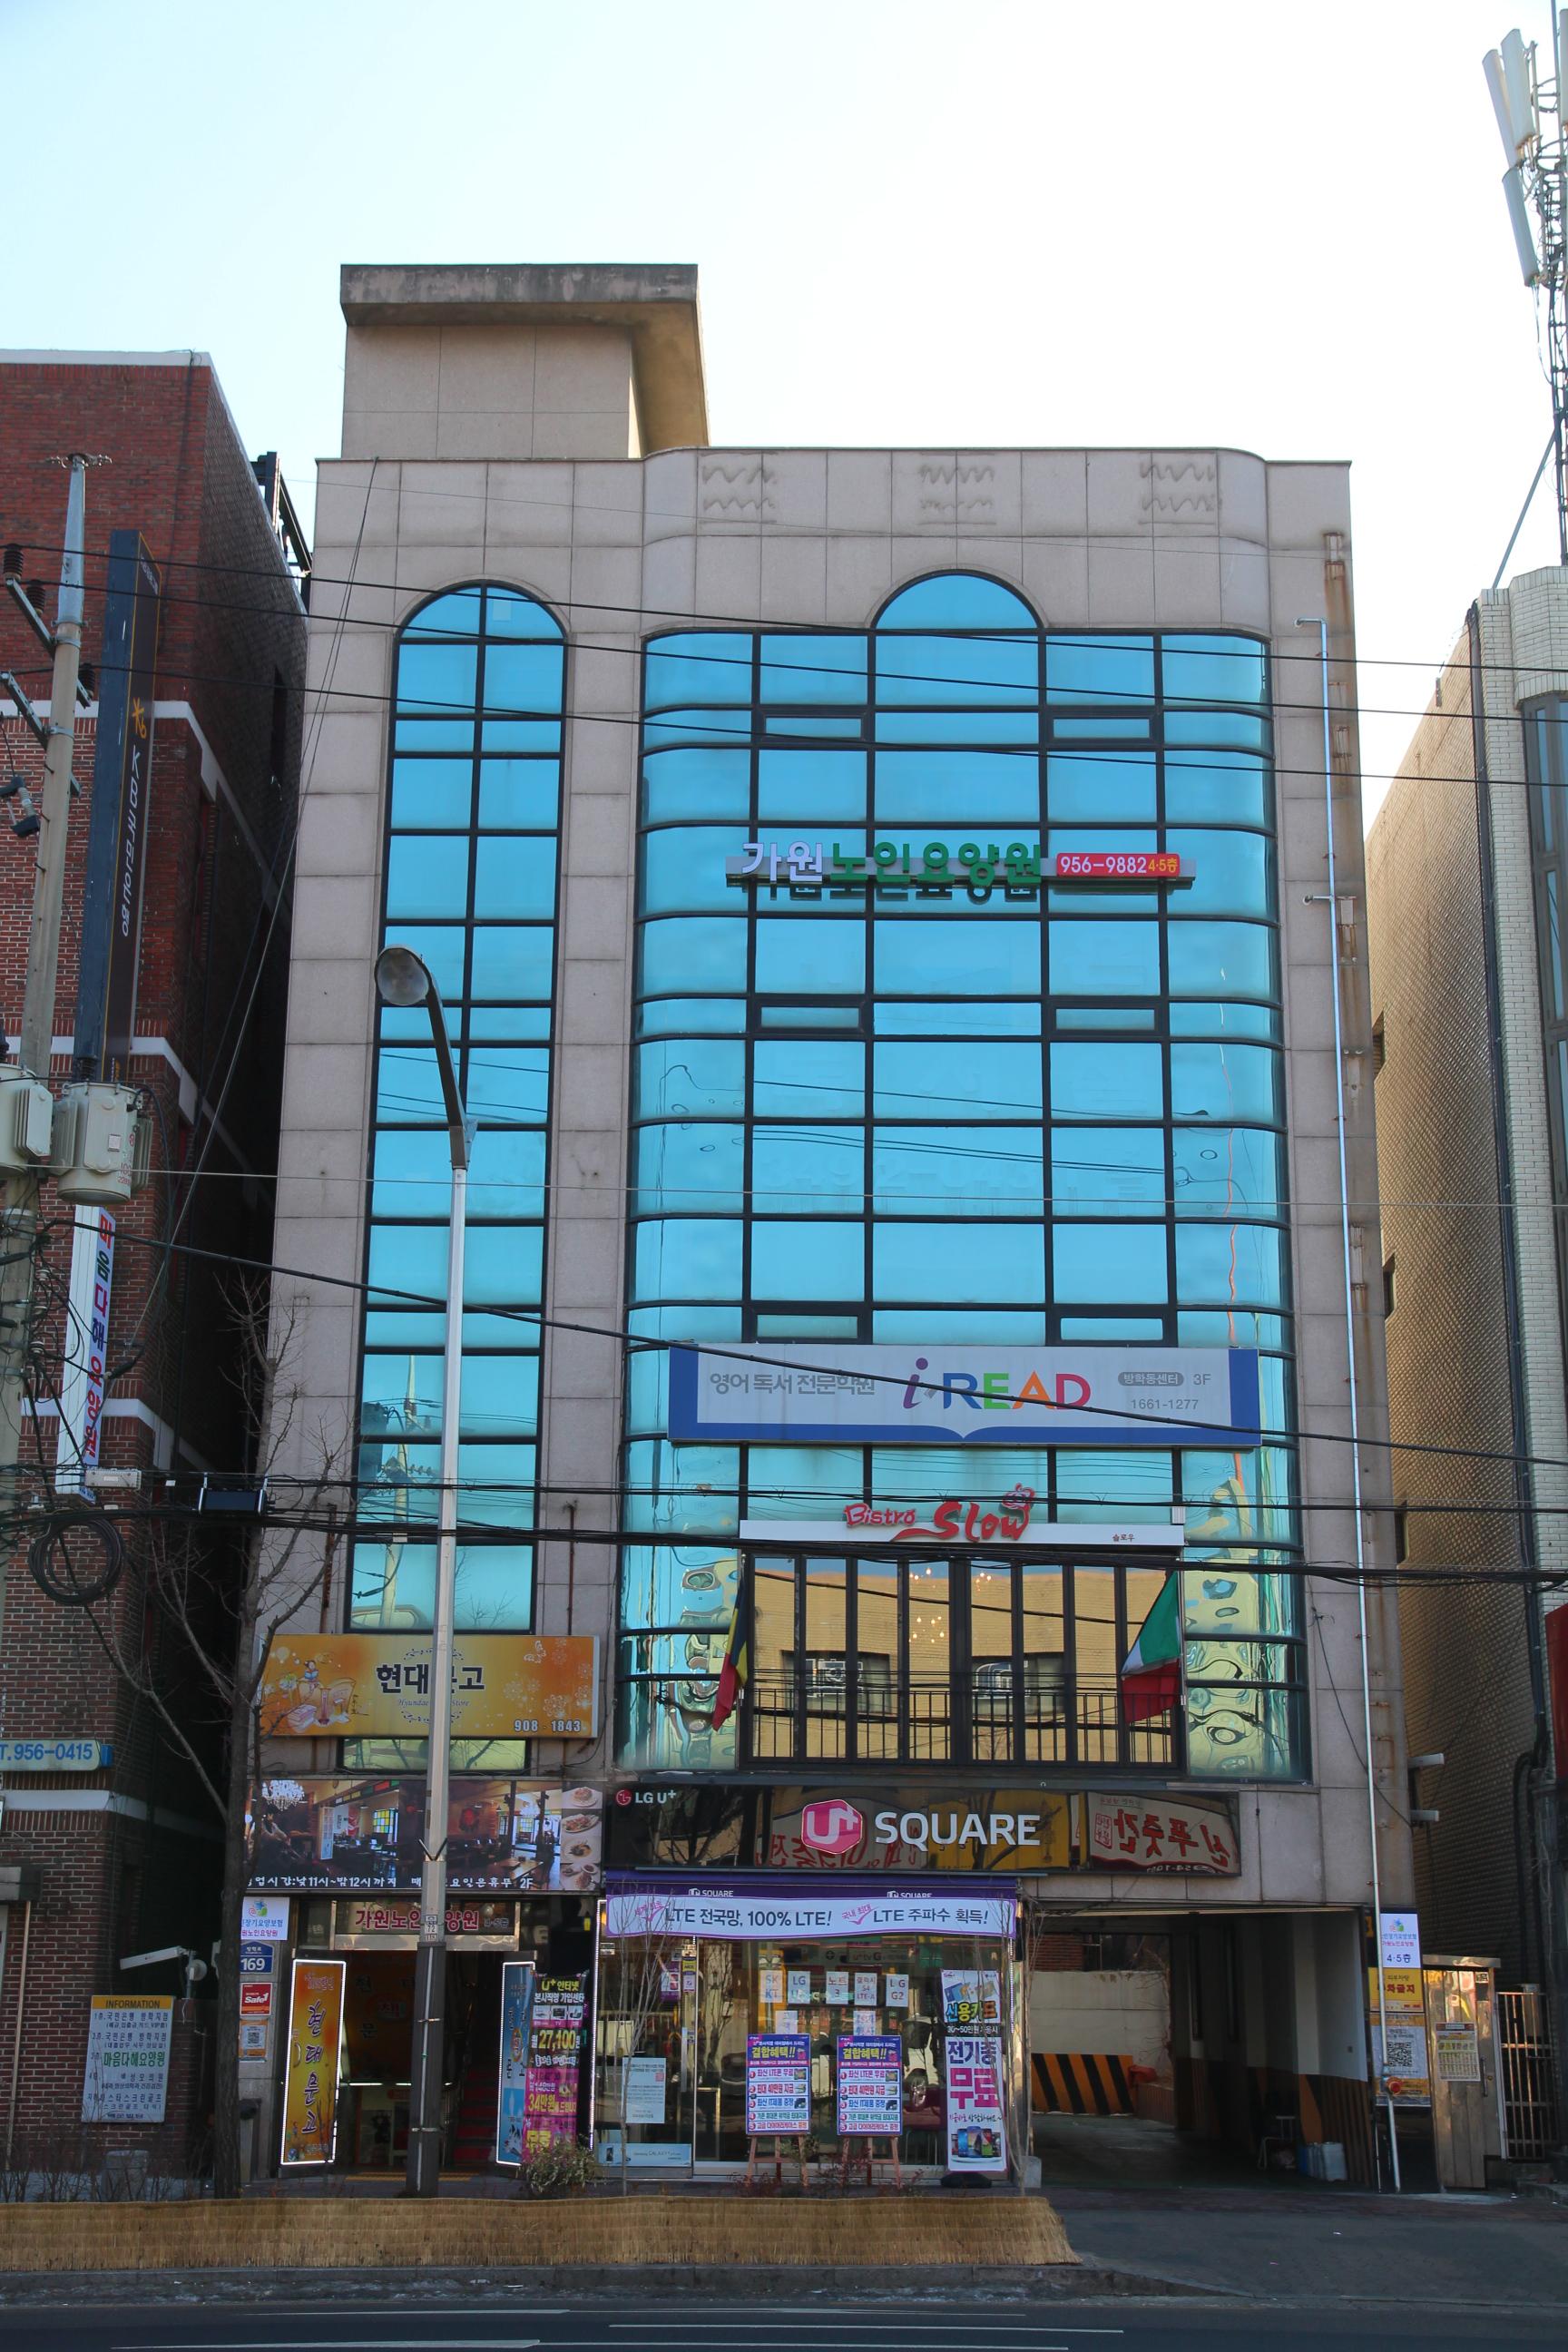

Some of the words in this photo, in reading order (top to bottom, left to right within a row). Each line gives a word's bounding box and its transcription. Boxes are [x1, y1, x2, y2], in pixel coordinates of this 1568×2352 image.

[1061, 855, 1147, 875] 956-9882
[710, 1373, 750, 1395] 영어
[753, 1374, 792, 1395] 독서
[797, 1374, 876, 1396] 전문학원
[1123, 1372, 1179, 1386] 방학동센터
[1193, 1374, 1211, 1386] 3F
[1131, 1398, 1200, 1410] 1661-1277
[843, 1500, 916, 1529] Bistro
[889, 1493, 1033, 1543] Slow
[376, 1663, 485, 1695] 현대고
[514, 1720, 538, 1732] 908
[551, 1720, 582, 1732] 1843
[635, 1791, 653, 1804] LG
[875, 1811, 1041, 1852] SQUARE
[519, 1878, 534, 1889] 2F
[702, 1889, 734, 1898] SQUARE
[700, 1909, 743, 1927] 전국망,
[748, 1910, 792, 1927] 100%
[795, 1910, 832, 1927] LTE!
[873, 1910, 905, 1924] LTE
[908, 1908, 951, 1925] 주파수
[955, 1908, 989, 1925] 획득!
[240, 1957, 266, 1971] 169
[557, 1981, 580, 1992] 인터넷
[792, 1975, 807, 1985] LG
[891, 1992, 904, 2000] G2
[105, 1999, 161, 2009] INFORMATION
[948, 2041, 997, 2064] 전기종
[950, 2067, 1000, 2110] 무료
